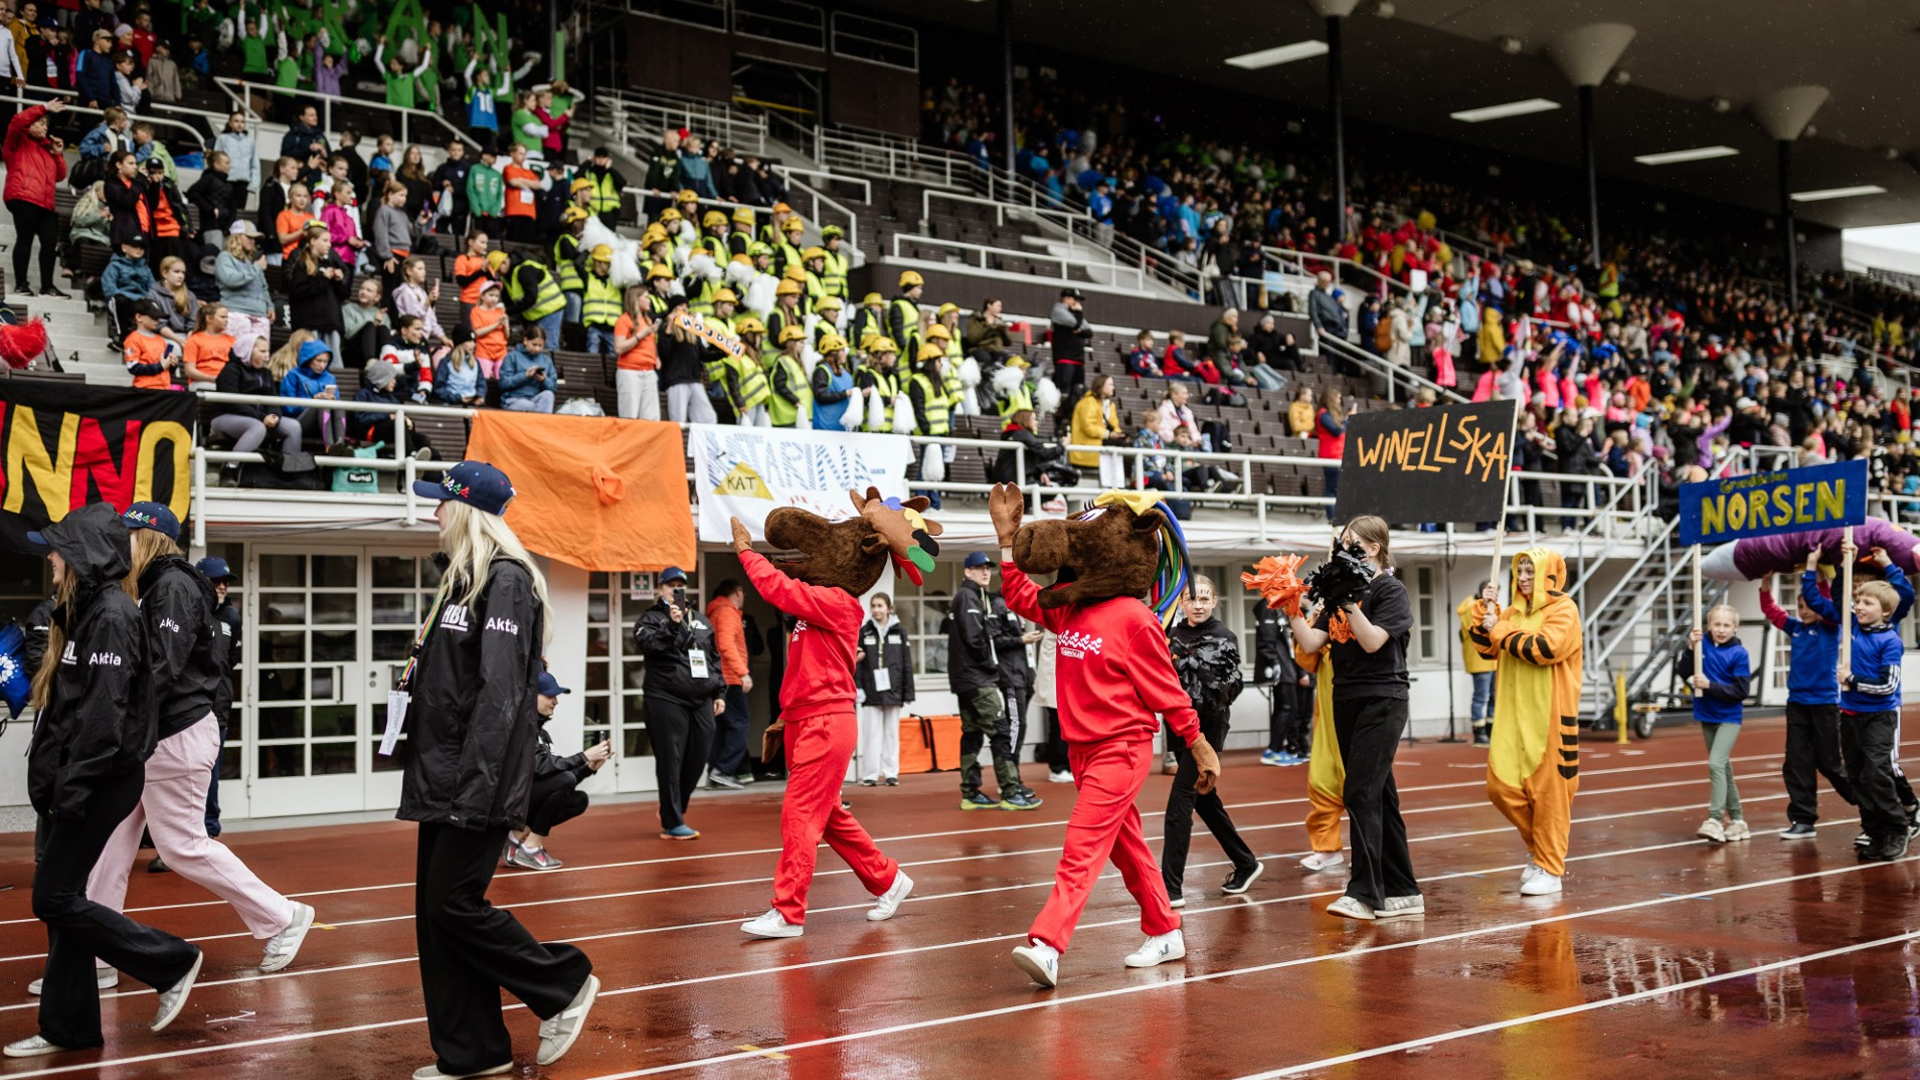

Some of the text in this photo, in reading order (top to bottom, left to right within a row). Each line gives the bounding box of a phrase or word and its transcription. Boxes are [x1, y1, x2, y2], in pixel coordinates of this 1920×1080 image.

[69, 350, 80, 362] 4
[1357, 412, 1508, 483] WINELLSKA
[349, 473, 372, 482] Normal
[727, 476, 757, 490] KAT
[1701, 478, 1846, 537] NORSEN
[440, 603, 469, 627] HBL
[485, 616, 519, 636] Aktia
[89, 651, 122, 667] Aktia
